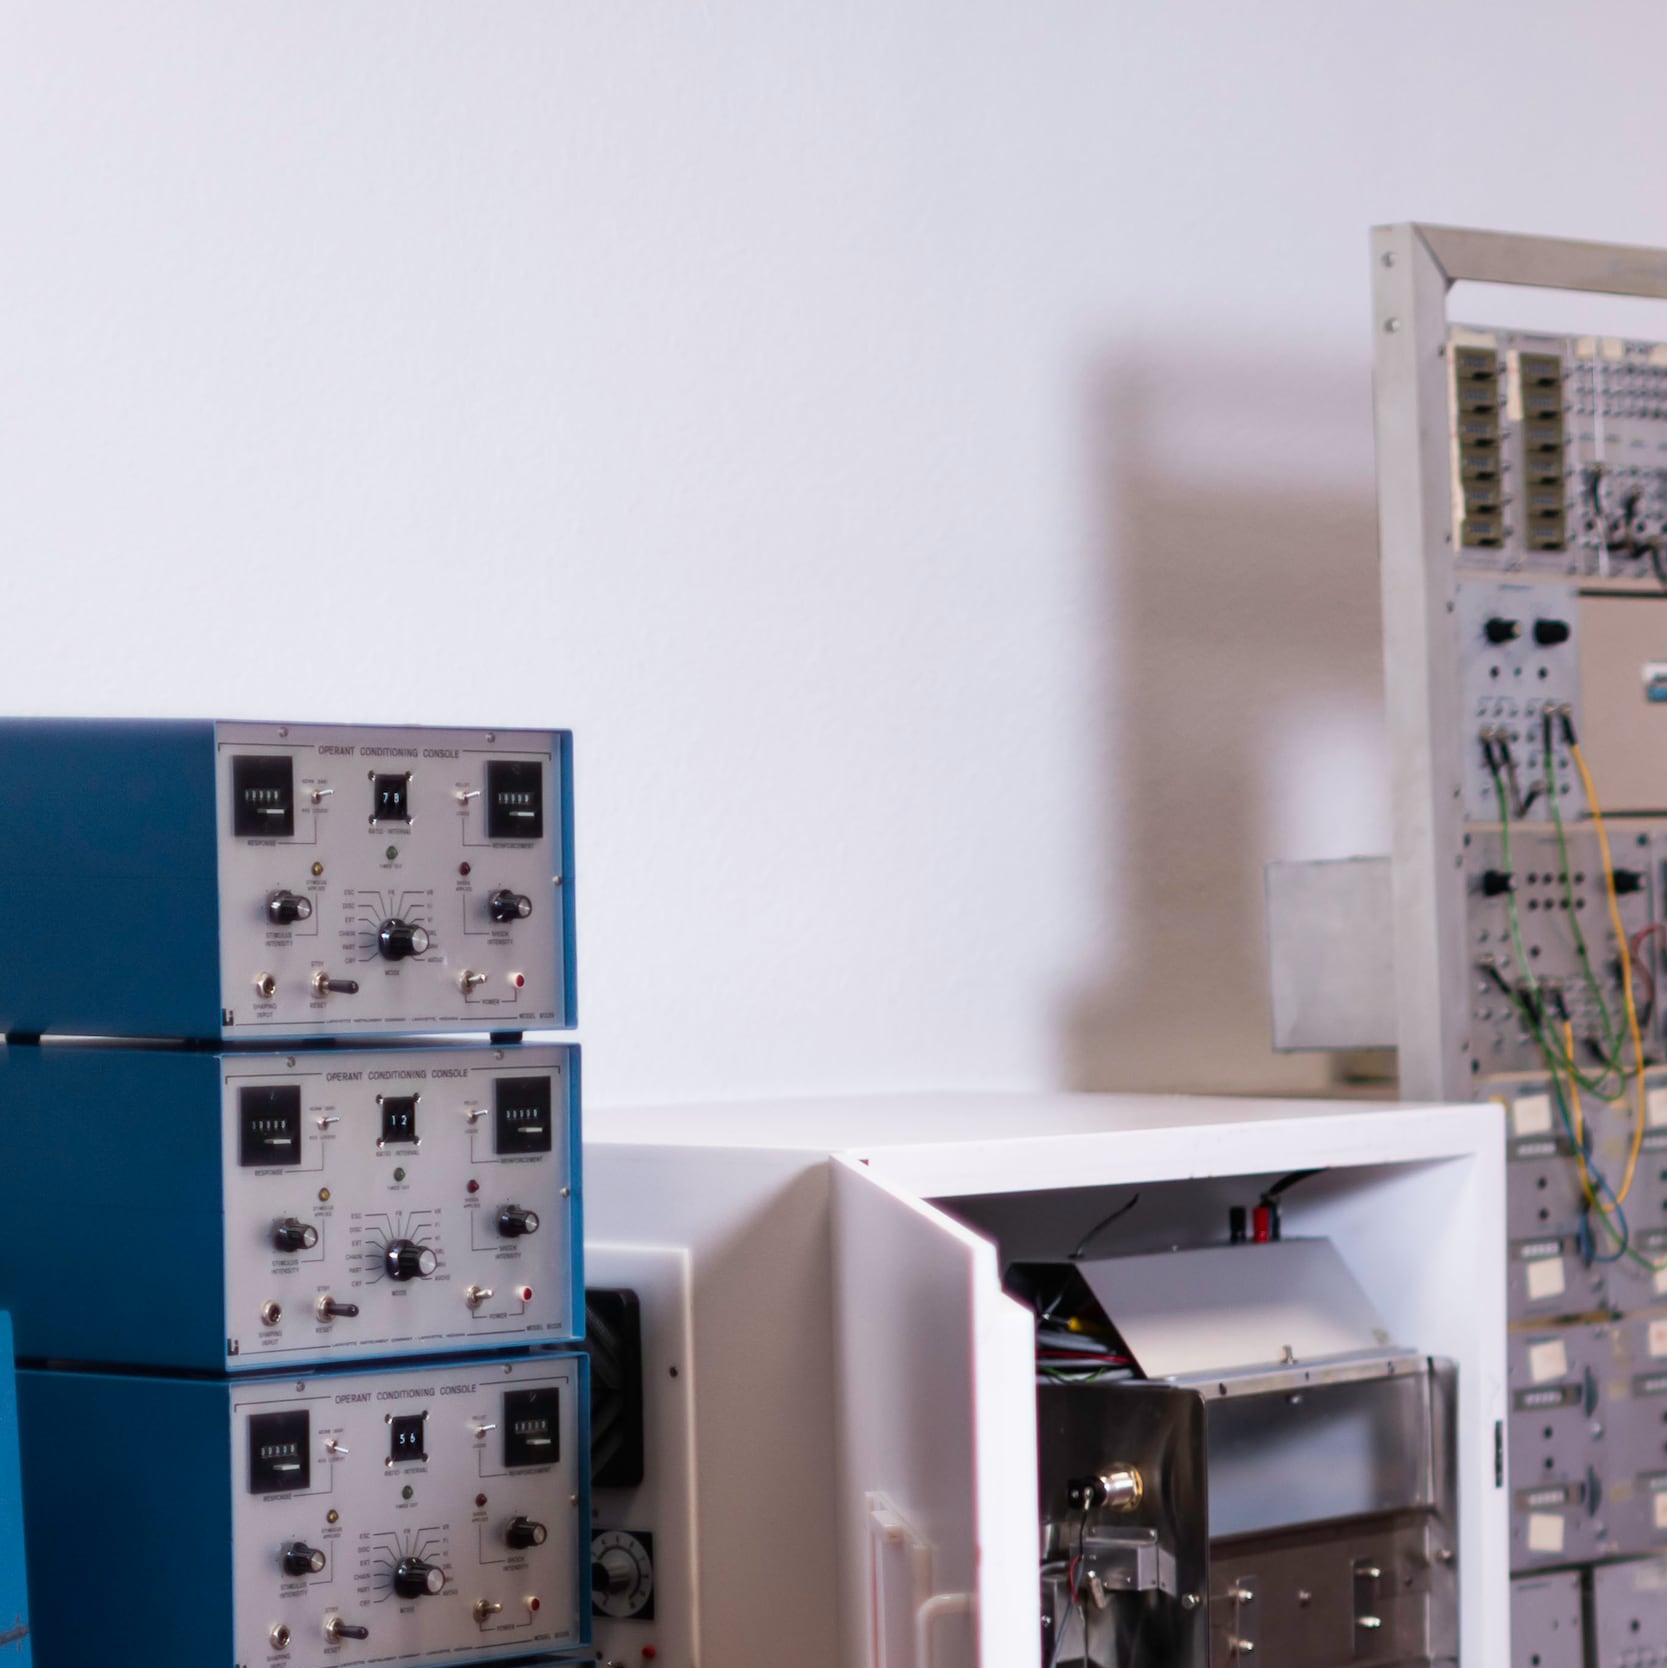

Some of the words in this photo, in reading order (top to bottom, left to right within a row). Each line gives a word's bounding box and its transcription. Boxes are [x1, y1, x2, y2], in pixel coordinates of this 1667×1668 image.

[318, 745, 354, 755] OPERANT
[360, 747, 417, 757] CONDITIONING
[423, 748, 459, 758] CONSOLE
[326, 1071, 362, 1083] OPERANT
[368, 1068, 426, 1082] CONDITIONING
[431, 1067, 468, 1079] CONSOLE
[335, 1392, 371, 1406] OPERANT
[376, 1386, 434, 1402] CONDITIONING
[440, 1383, 476, 1396] CONSOLE
